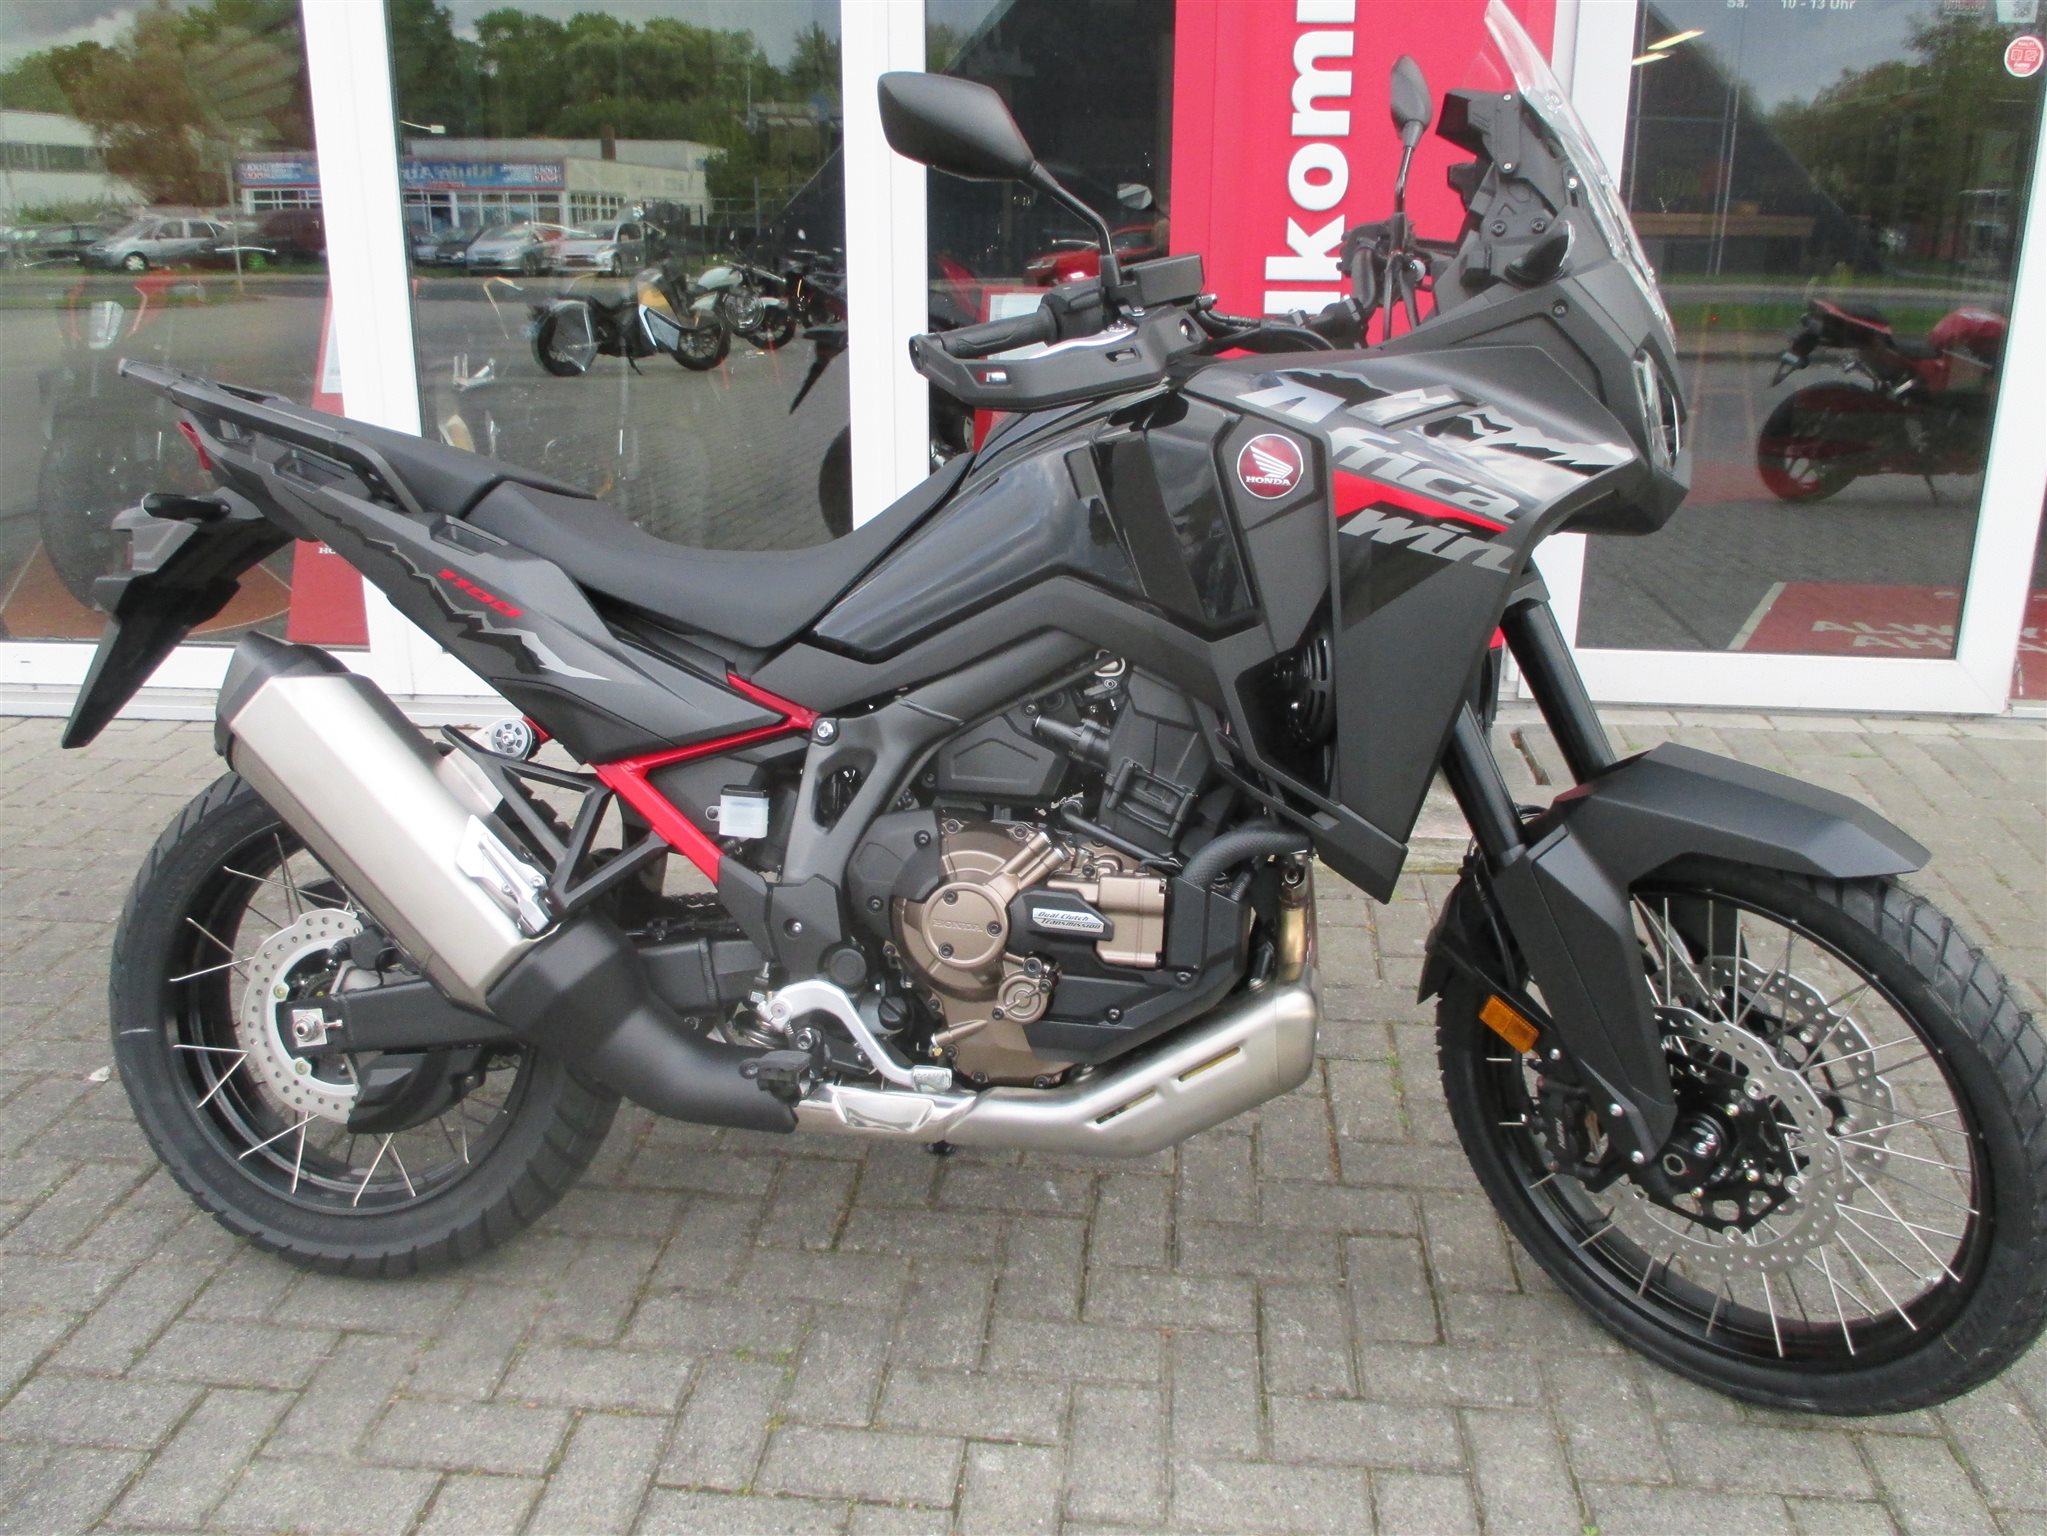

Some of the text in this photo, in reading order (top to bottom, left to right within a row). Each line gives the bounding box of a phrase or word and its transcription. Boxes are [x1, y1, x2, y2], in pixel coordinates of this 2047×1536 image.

[1264, 0, 1356, 315] lkom
[1245, 475, 1292, 487] HONDA
[1038, 911, 1089, 922] Dual Clutch
[931, 918, 983, 933] HONDA
[1041, 917, 1101, 930] Transmission
